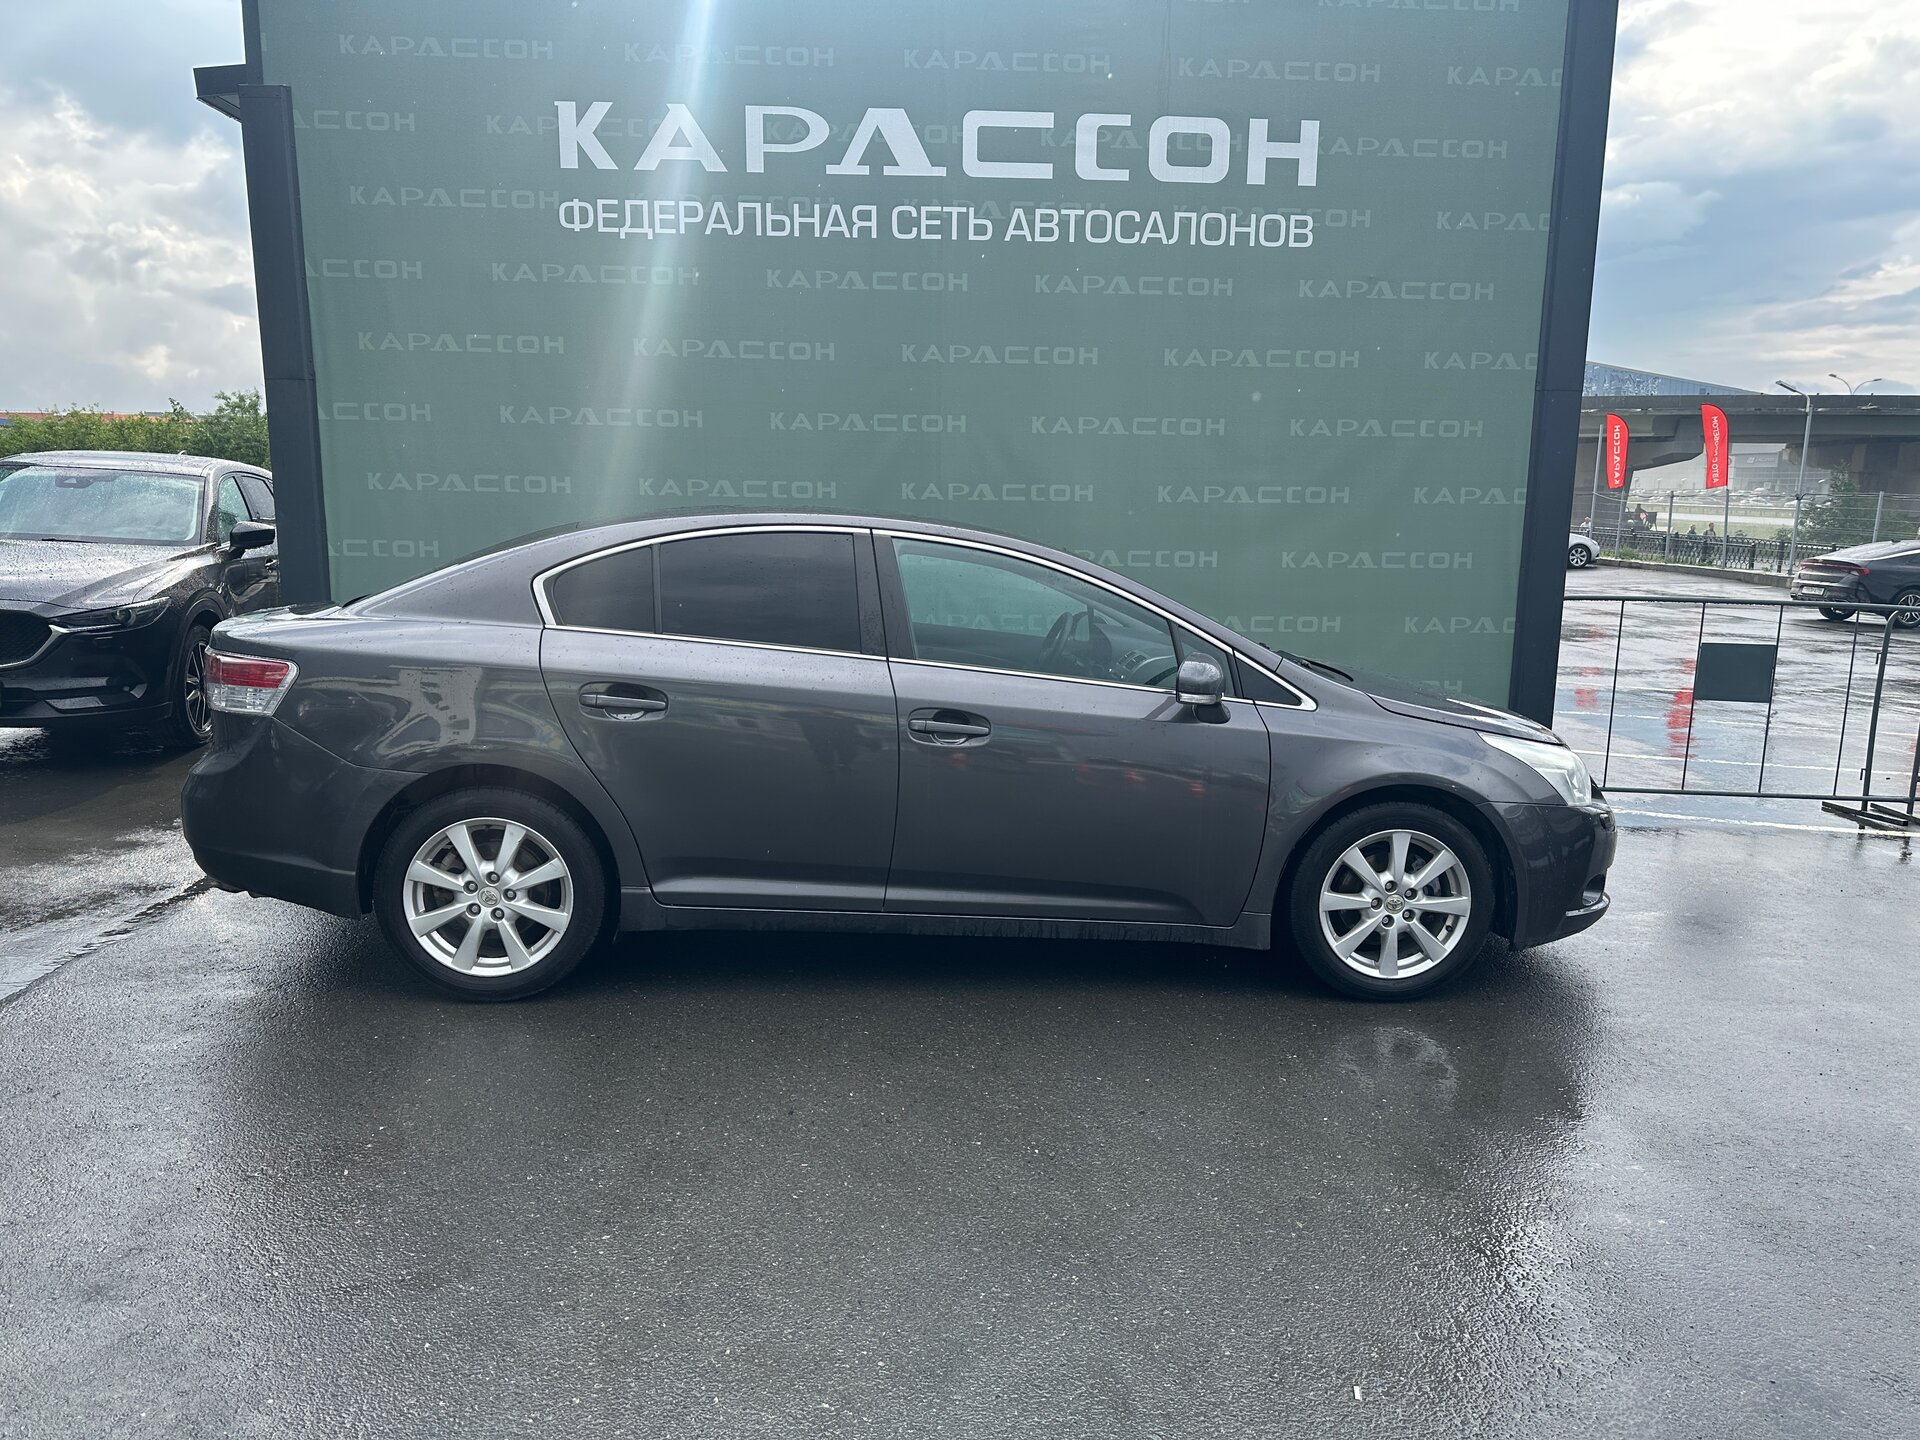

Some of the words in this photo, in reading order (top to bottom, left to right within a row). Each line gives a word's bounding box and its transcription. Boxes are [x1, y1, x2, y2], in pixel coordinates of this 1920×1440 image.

[1317, 136, 1508, 159] АРЛССОН
[559, 199, 878, 240] ФЕДЕРАЛЬНАЯ
[891, 206, 994, 241] СЕТЬ
[1003, 208, 1314, 248] АВТОСАЛОНОВ
